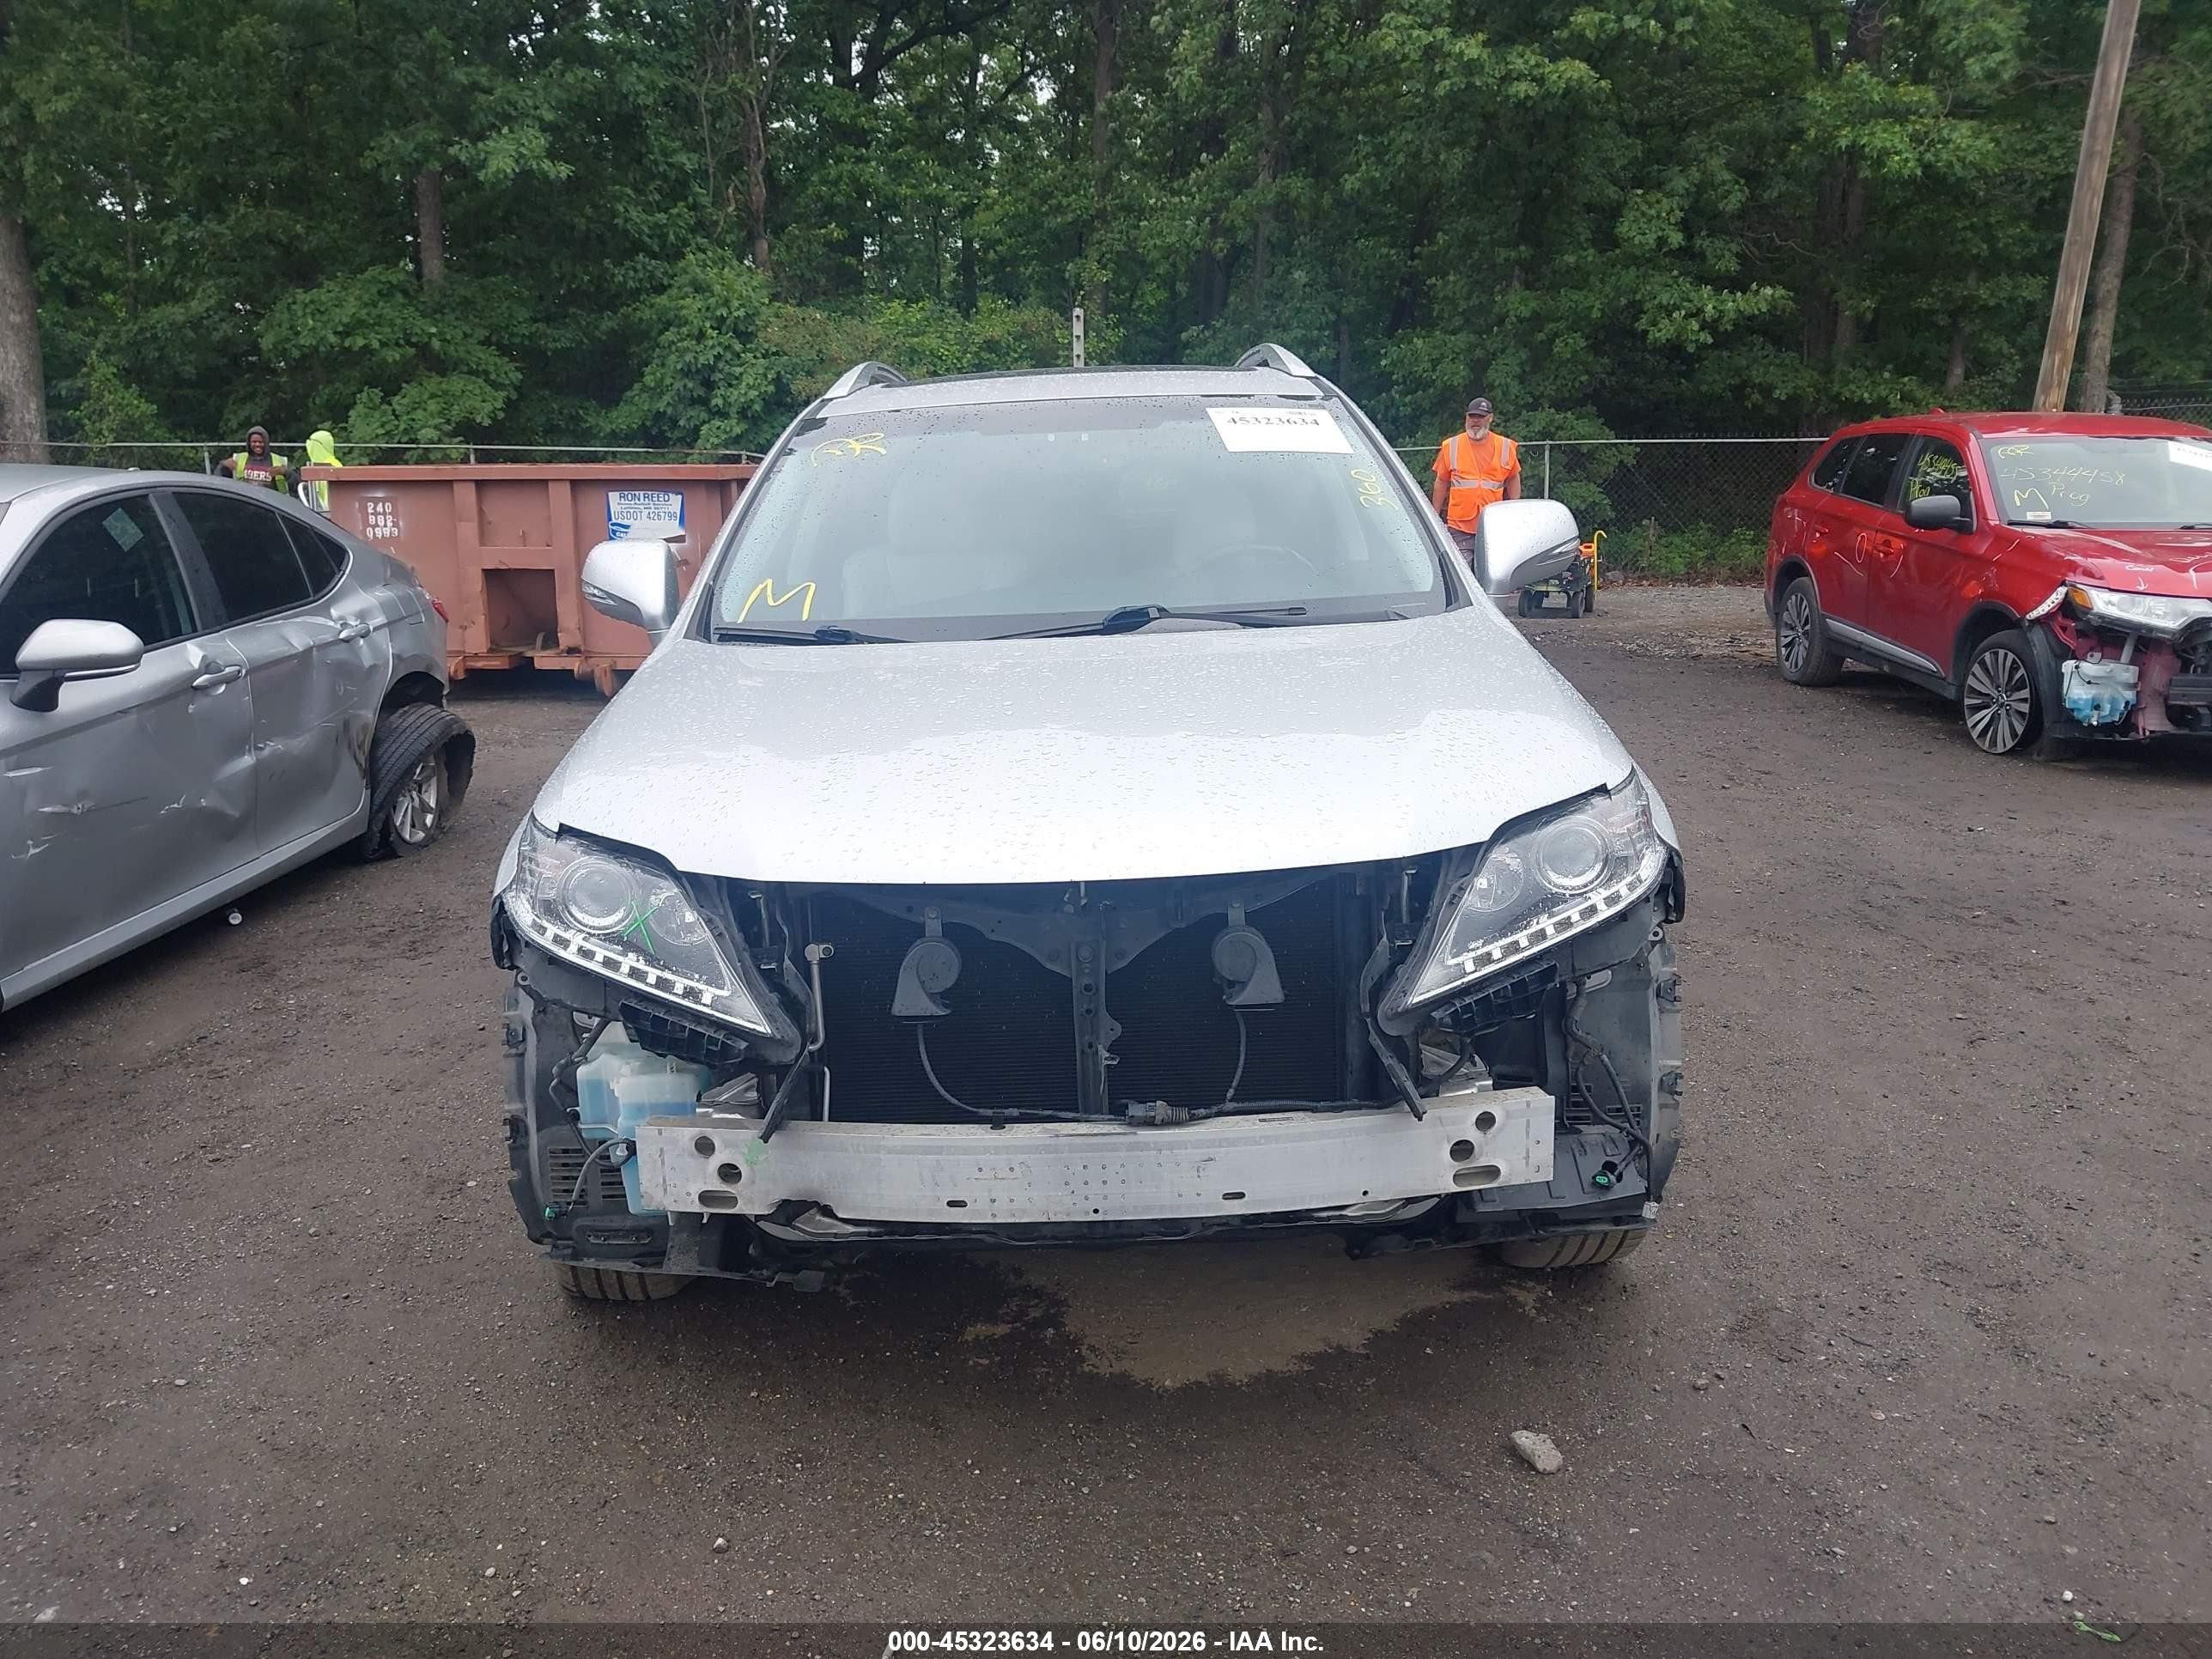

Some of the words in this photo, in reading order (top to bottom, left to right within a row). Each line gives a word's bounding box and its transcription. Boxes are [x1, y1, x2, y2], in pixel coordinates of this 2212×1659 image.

[1227, 416, 1320, 426] 45323634
[619, 492, 641, 502] RON
[643, 493, 671, 502] REED
[2014, 488, 2050, 510] M
[367, 501, 392, 514] 240
[613, 510, 643, 520] USDOT
[646, 511, 678, 521] 426799
[736, 578, 816, 623] M
